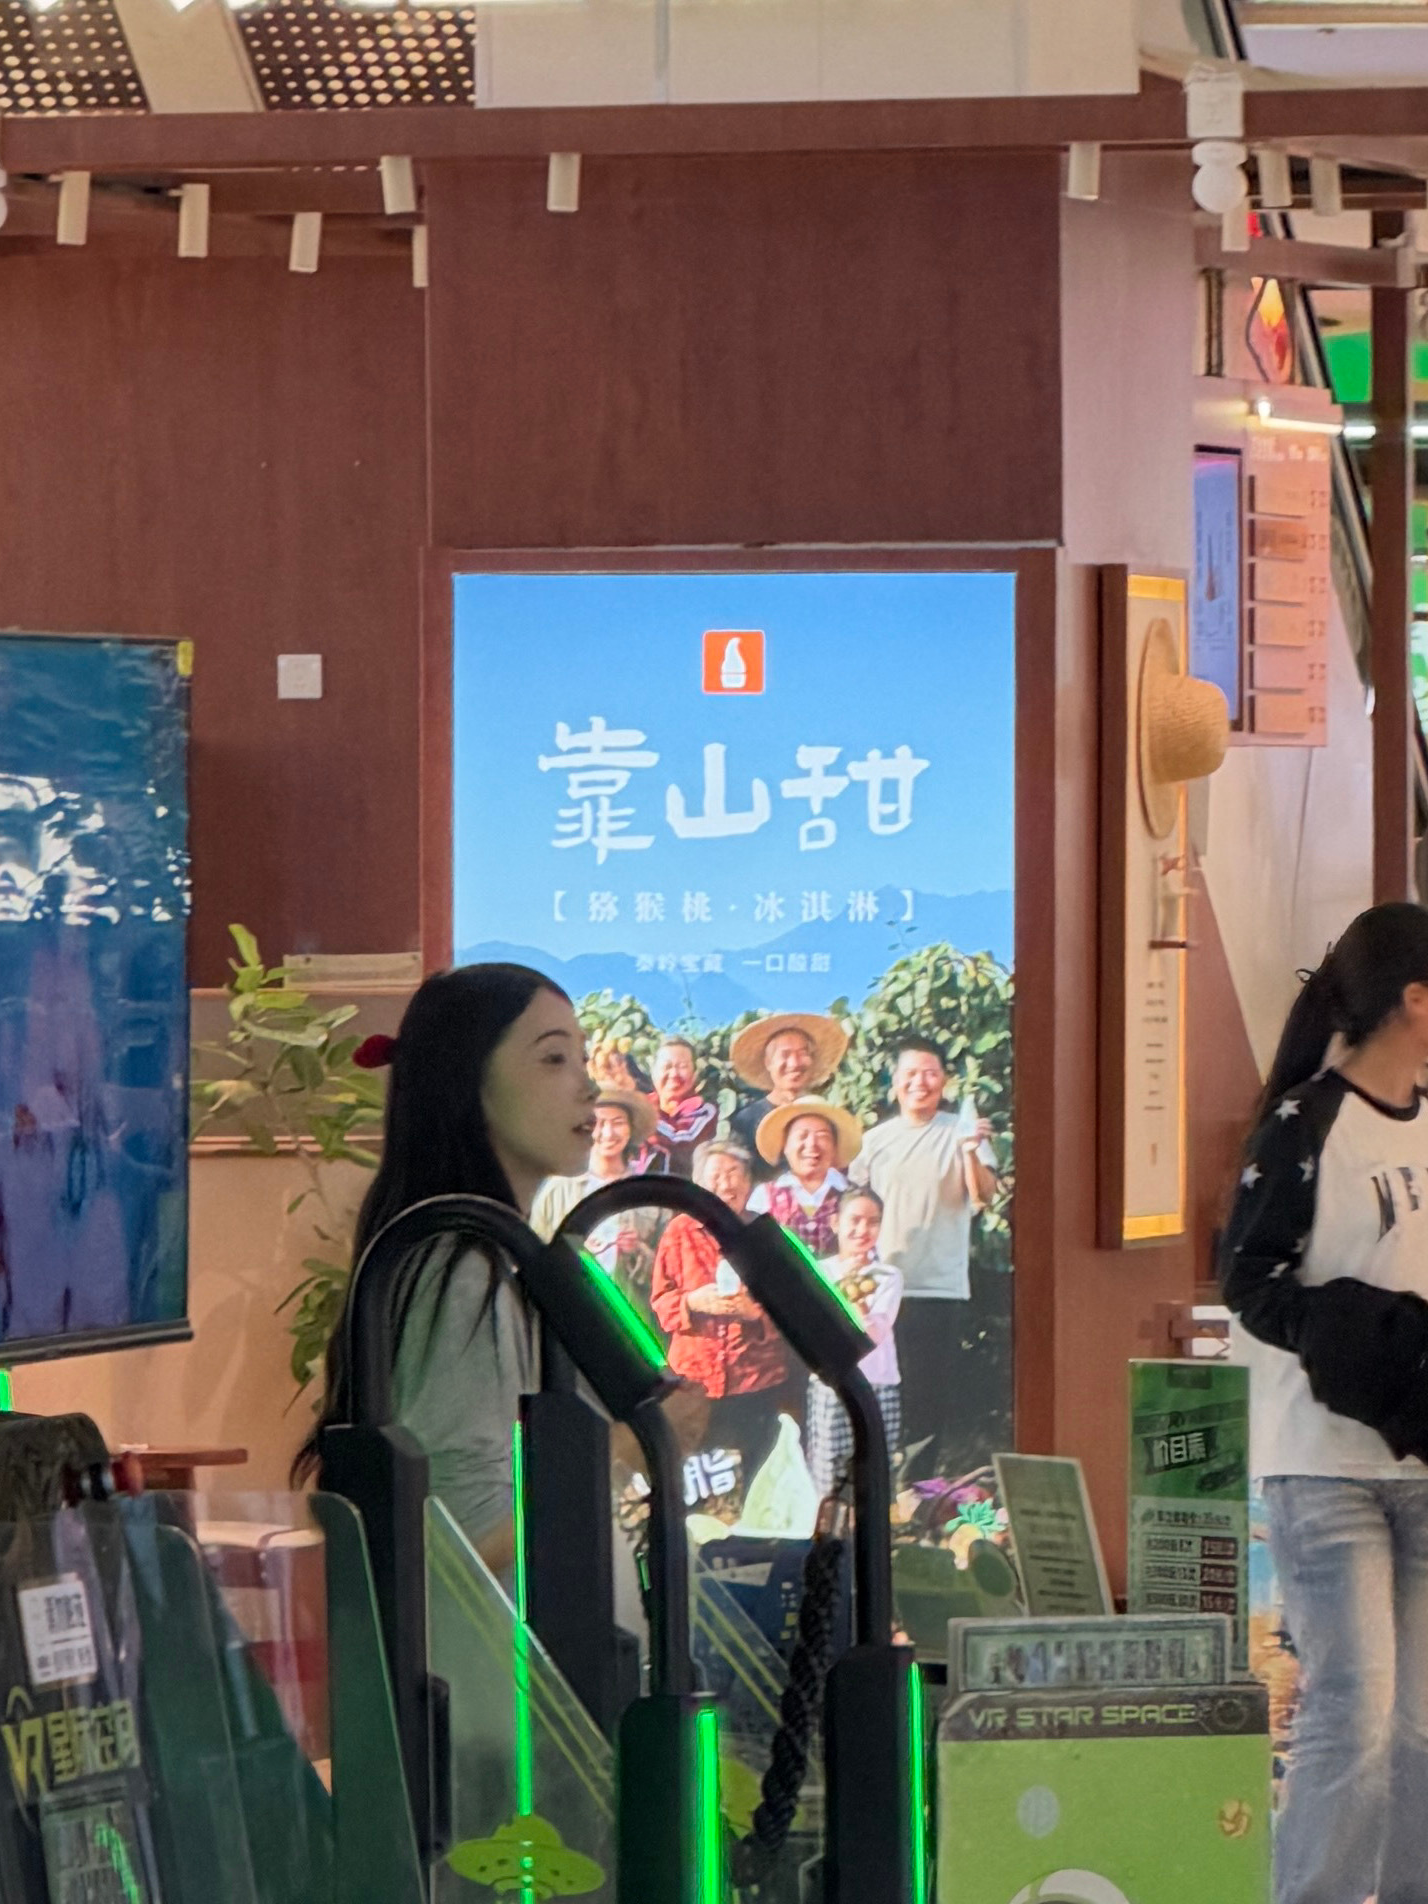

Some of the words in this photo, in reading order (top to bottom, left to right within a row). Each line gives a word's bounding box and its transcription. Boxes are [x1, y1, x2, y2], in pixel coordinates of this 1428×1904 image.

[537, 716, 931, 865] 靠山甜
[968, 1707, 1007, 1729] VR
[1016, 1705, 1094, 1728] STAR
[1101, 1702, 1197, 1726] SPACE
